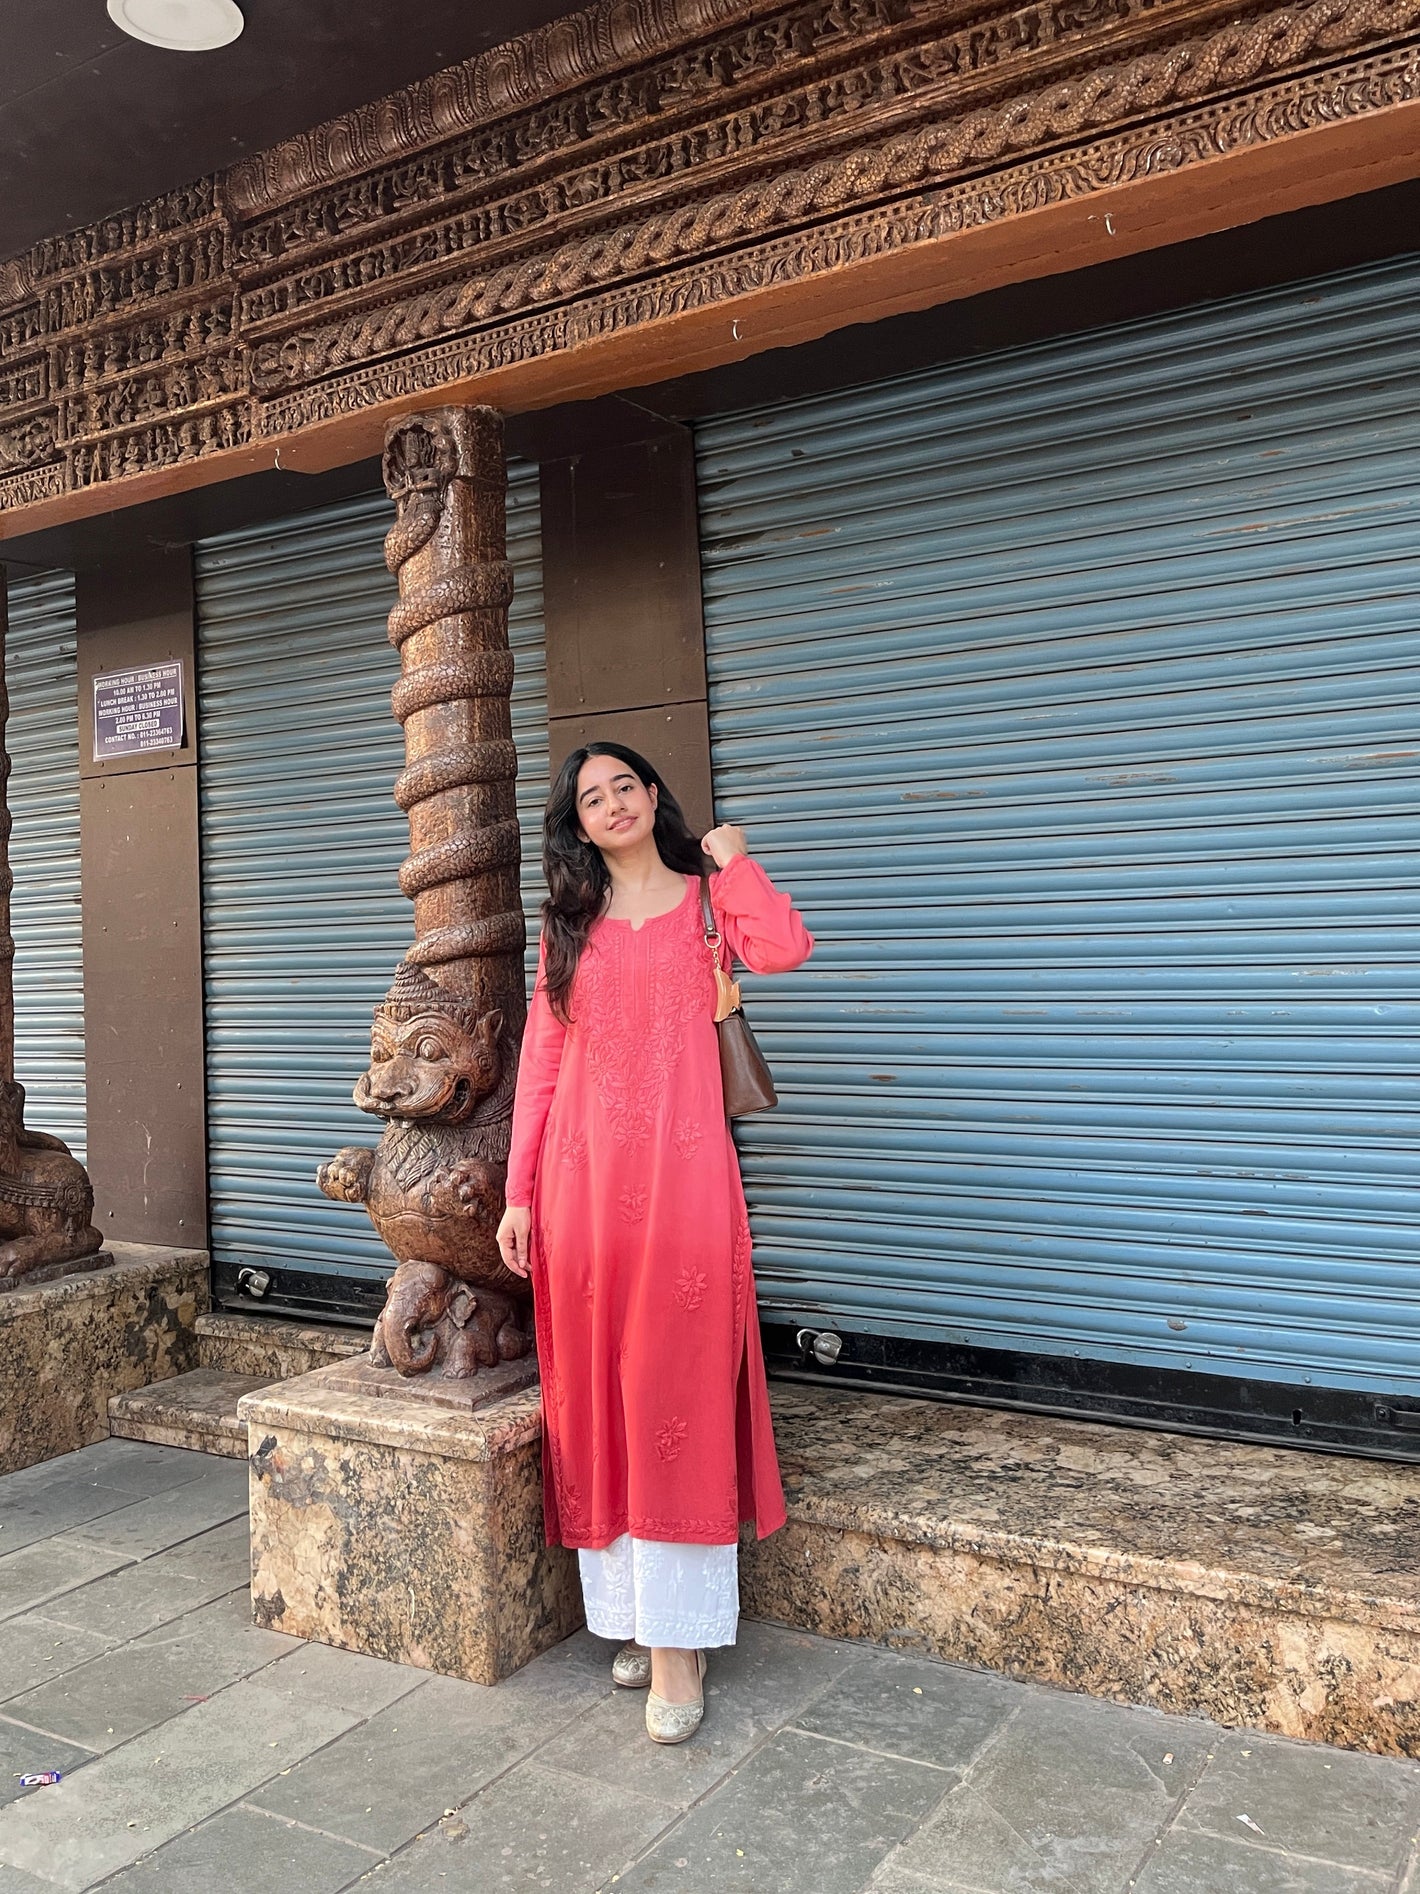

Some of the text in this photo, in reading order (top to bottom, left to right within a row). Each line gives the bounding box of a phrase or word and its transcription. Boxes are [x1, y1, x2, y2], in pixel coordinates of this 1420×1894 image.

[121, 676, 134, 684] HOUR
[162, 668, 176, 677] HOUR
[114, 688, 126, 696] 10.00
[126, 686, 134, 694] AM
[143, 683, 152, 691] 1.30
[154, 682, 161, 690] PM
[100, 698, 116, 708] LUNCH
[118, 696, 134, 704] BREAK
[138, 693, 148, 701] 1.30
[156, 690, 166, 698] 2.00
[98, 706, 120, 716] WORKING
[121, 704, 136, 713] HOUR
[138, 700, 162, 710] BUSINESS
[164, 697, 178, 706] HOUR
[116, 715, 126, 724] 2.00
[126, 714, 134, 722] PM
[134, 712, 142, 721] TO
[154, 710, 161, 718] PM
[118, 720, 158, 732] SUNDAY CLOSED
[105, 734, 126, 744] CONTACT
